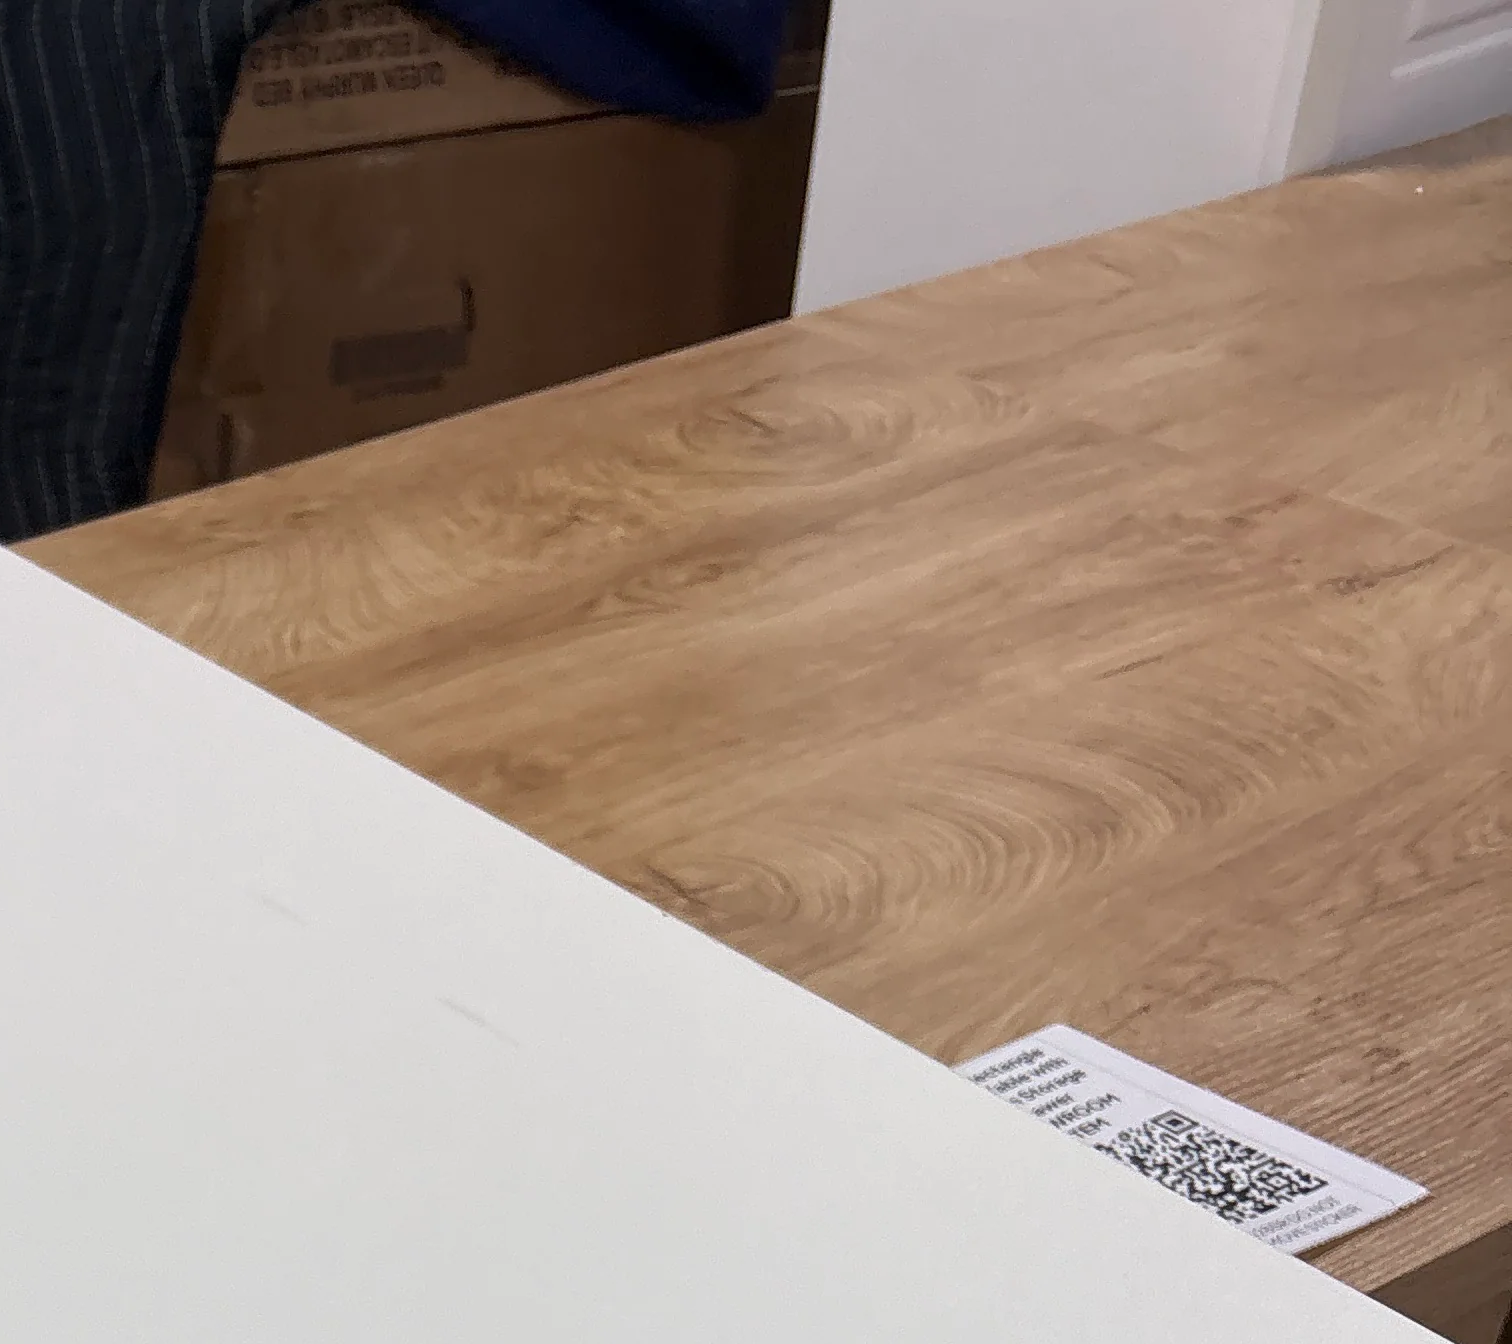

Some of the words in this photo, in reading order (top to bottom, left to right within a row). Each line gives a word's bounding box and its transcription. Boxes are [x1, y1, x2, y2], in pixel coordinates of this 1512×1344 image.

[968, 1048, 1044, 1085] ectangle
[985, 1073, 1032, 1095] able
[1029, 1056, 1071, 1077] with
[1017, 1069, 1087, 1101] Storage
